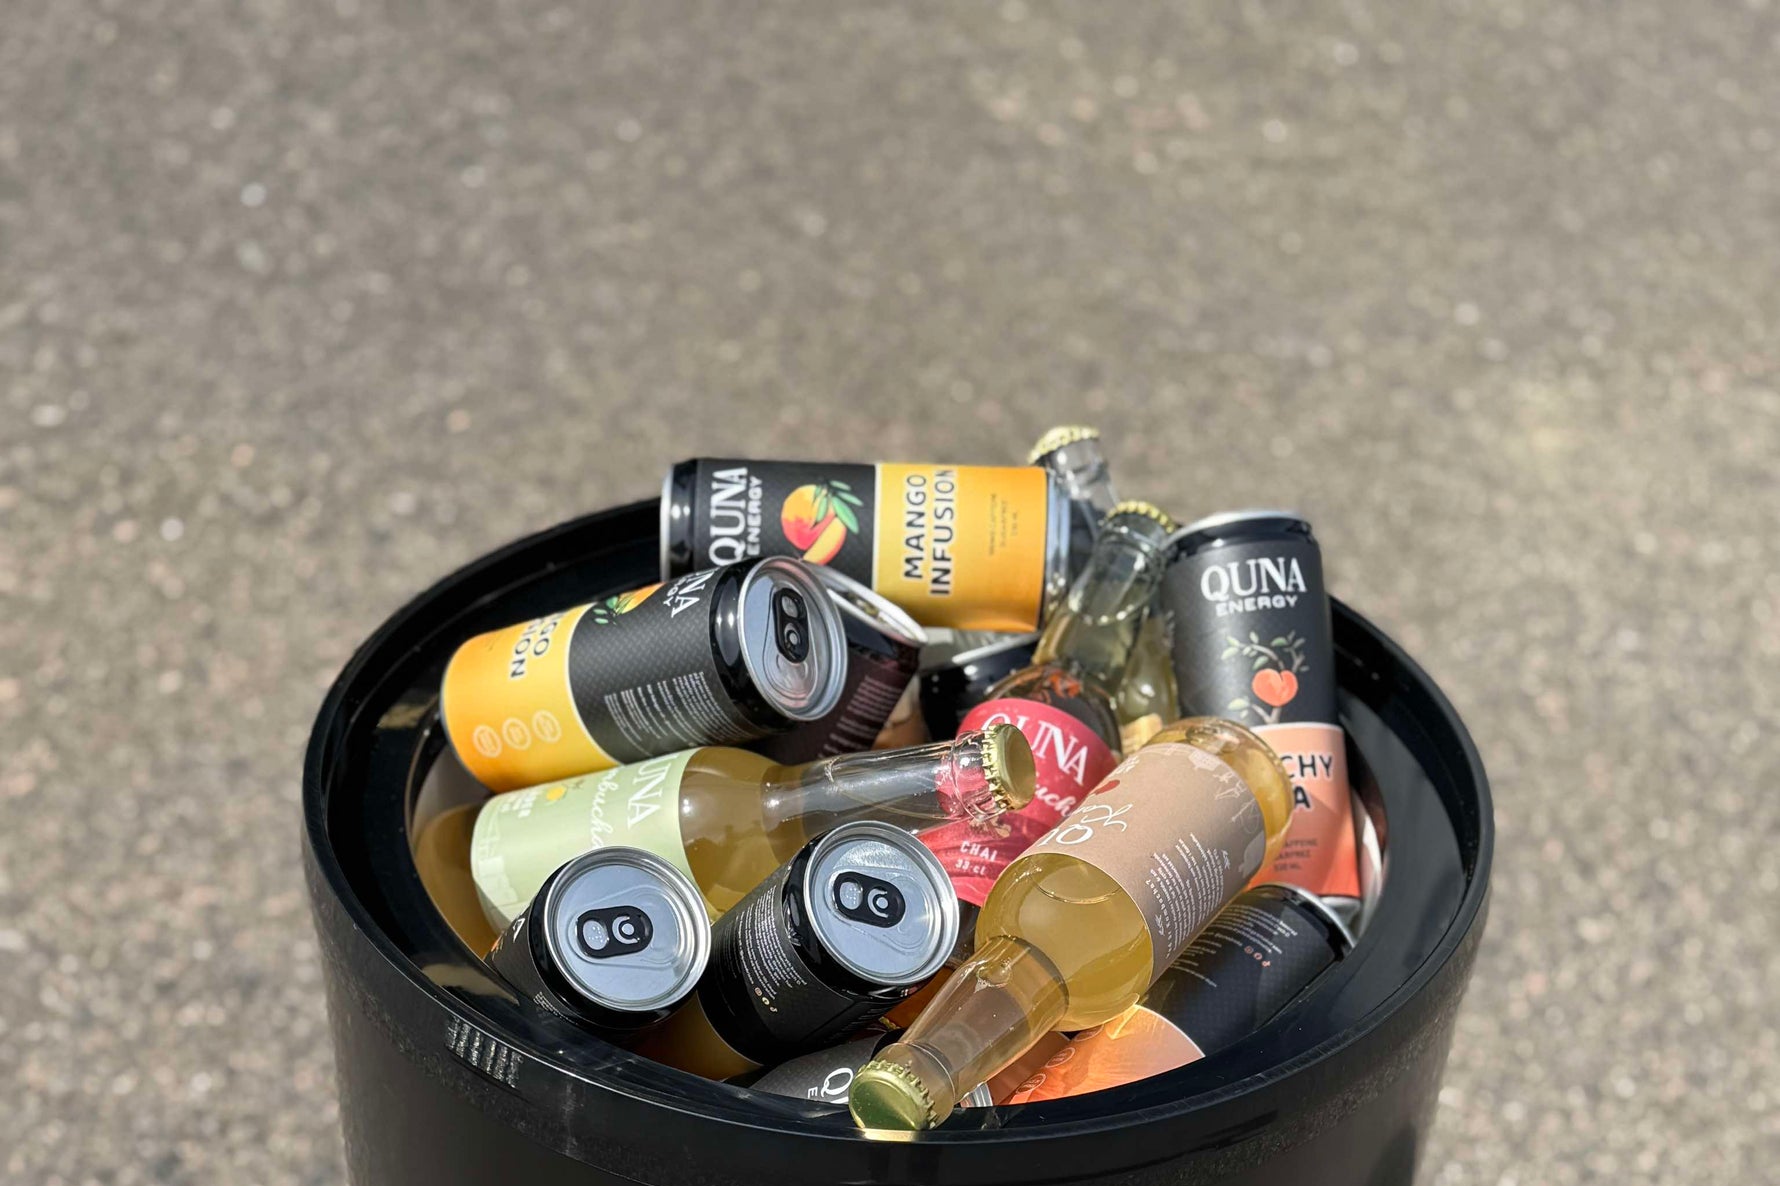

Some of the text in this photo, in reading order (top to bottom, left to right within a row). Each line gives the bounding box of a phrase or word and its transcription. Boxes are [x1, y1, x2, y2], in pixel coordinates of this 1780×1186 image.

[708, 467, 748, 566] QUNA
[747, 476, 763, 556] ENERGY
[904, 474, 927, 580] MANGO
[929, 468, 957, 596] INFUSION
[672, 568, 718, 618] NA
[1201, 557, 1307, 601] QUNA
[1215, 596, 1299, 617] ENERGY
[629, 753, 678, 828] UNA
[959, 839, 997, 861] CHAI
